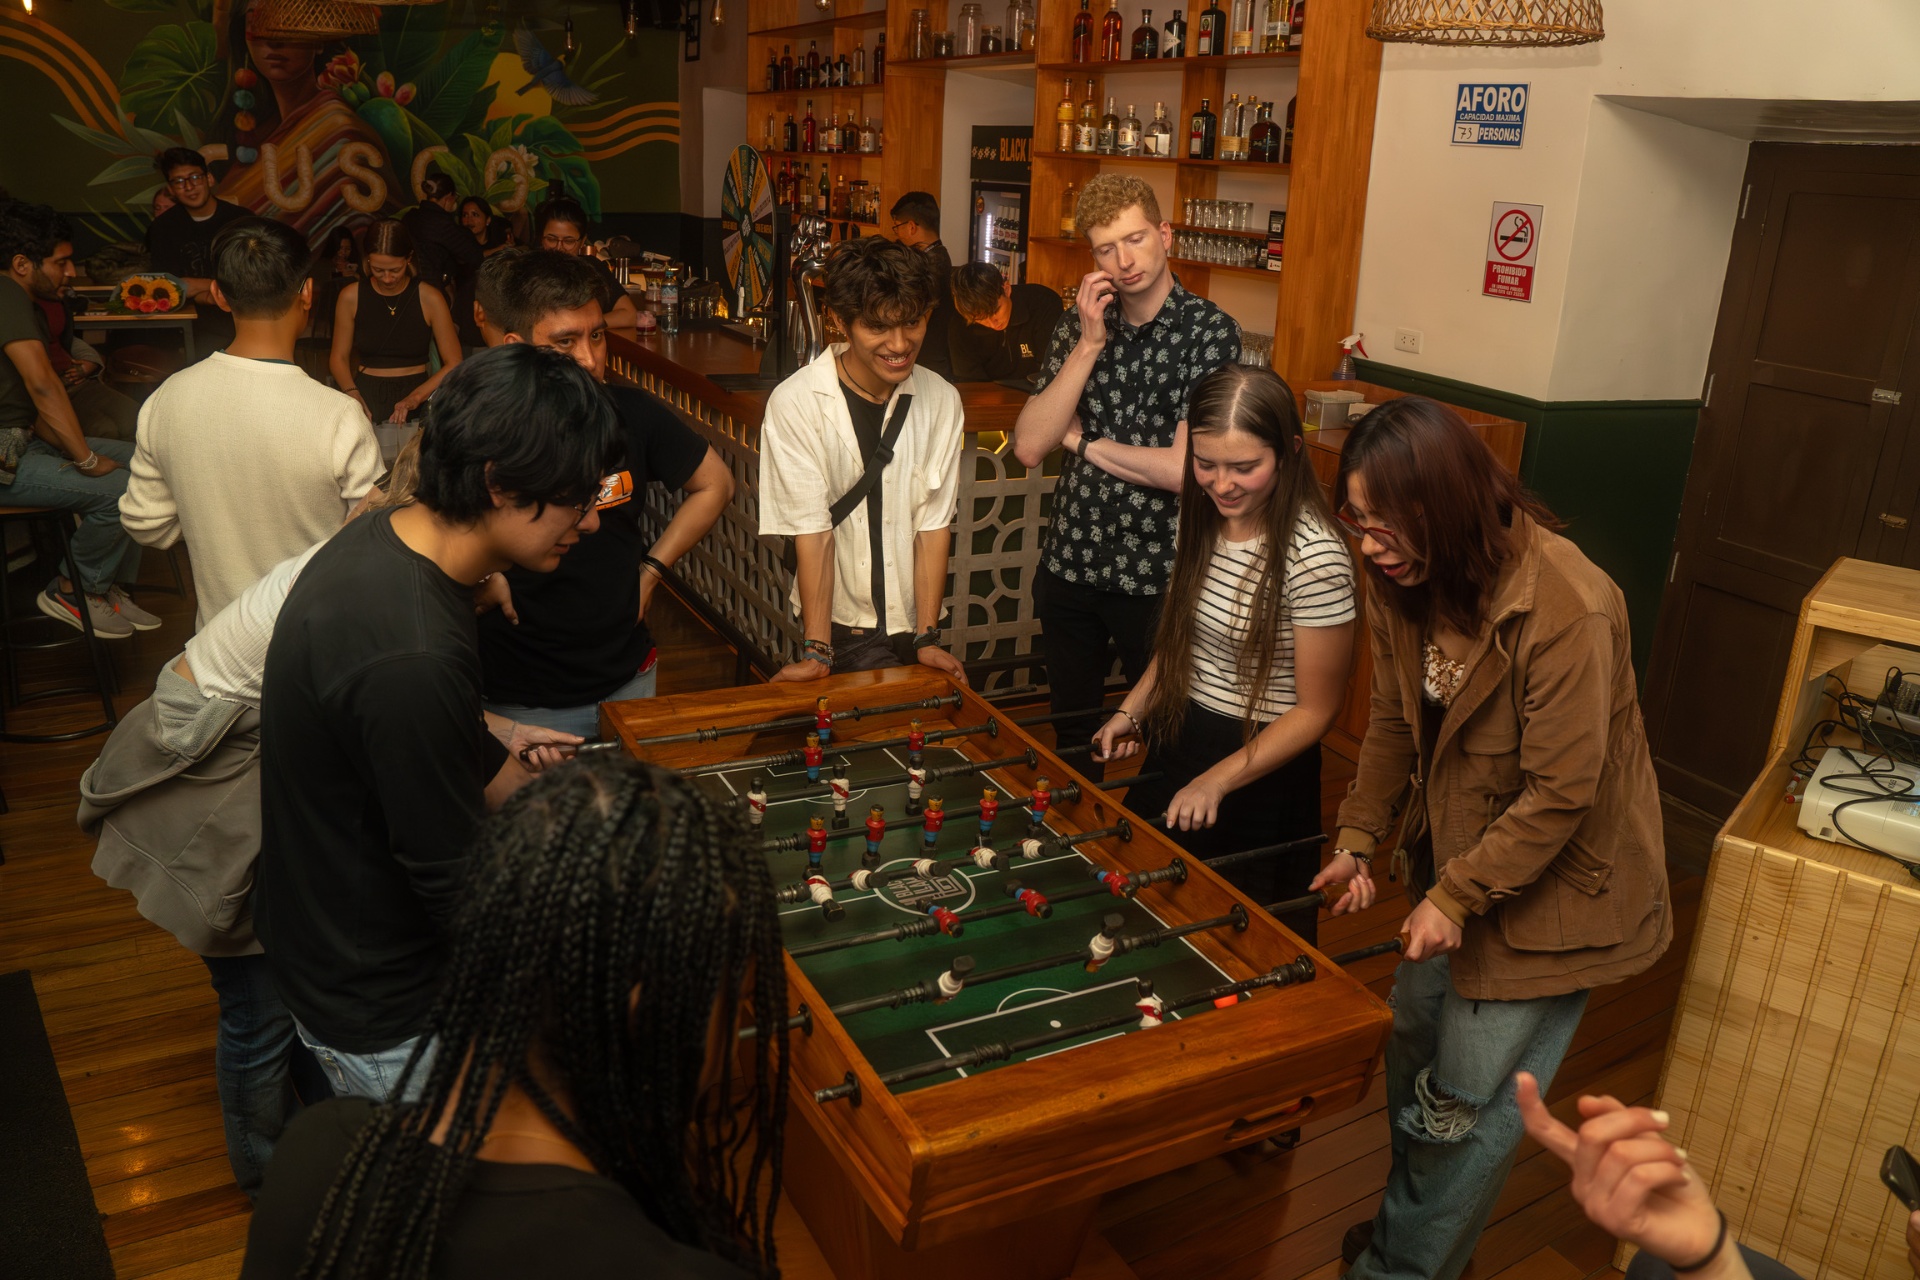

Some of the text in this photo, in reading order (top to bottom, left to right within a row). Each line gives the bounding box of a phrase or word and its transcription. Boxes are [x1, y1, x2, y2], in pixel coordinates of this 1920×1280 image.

[1457, 86, 1526, 113] AFORO
[1458, 126, 1473, 140] 73
[1479, 127, 1520, 142] PERSONAS
[1000, 137, 1026, 162] BLACK
[1492, 264, 1527, 277] PROHIBIDO
[1497, 274, 1519, 286] FUMAR
